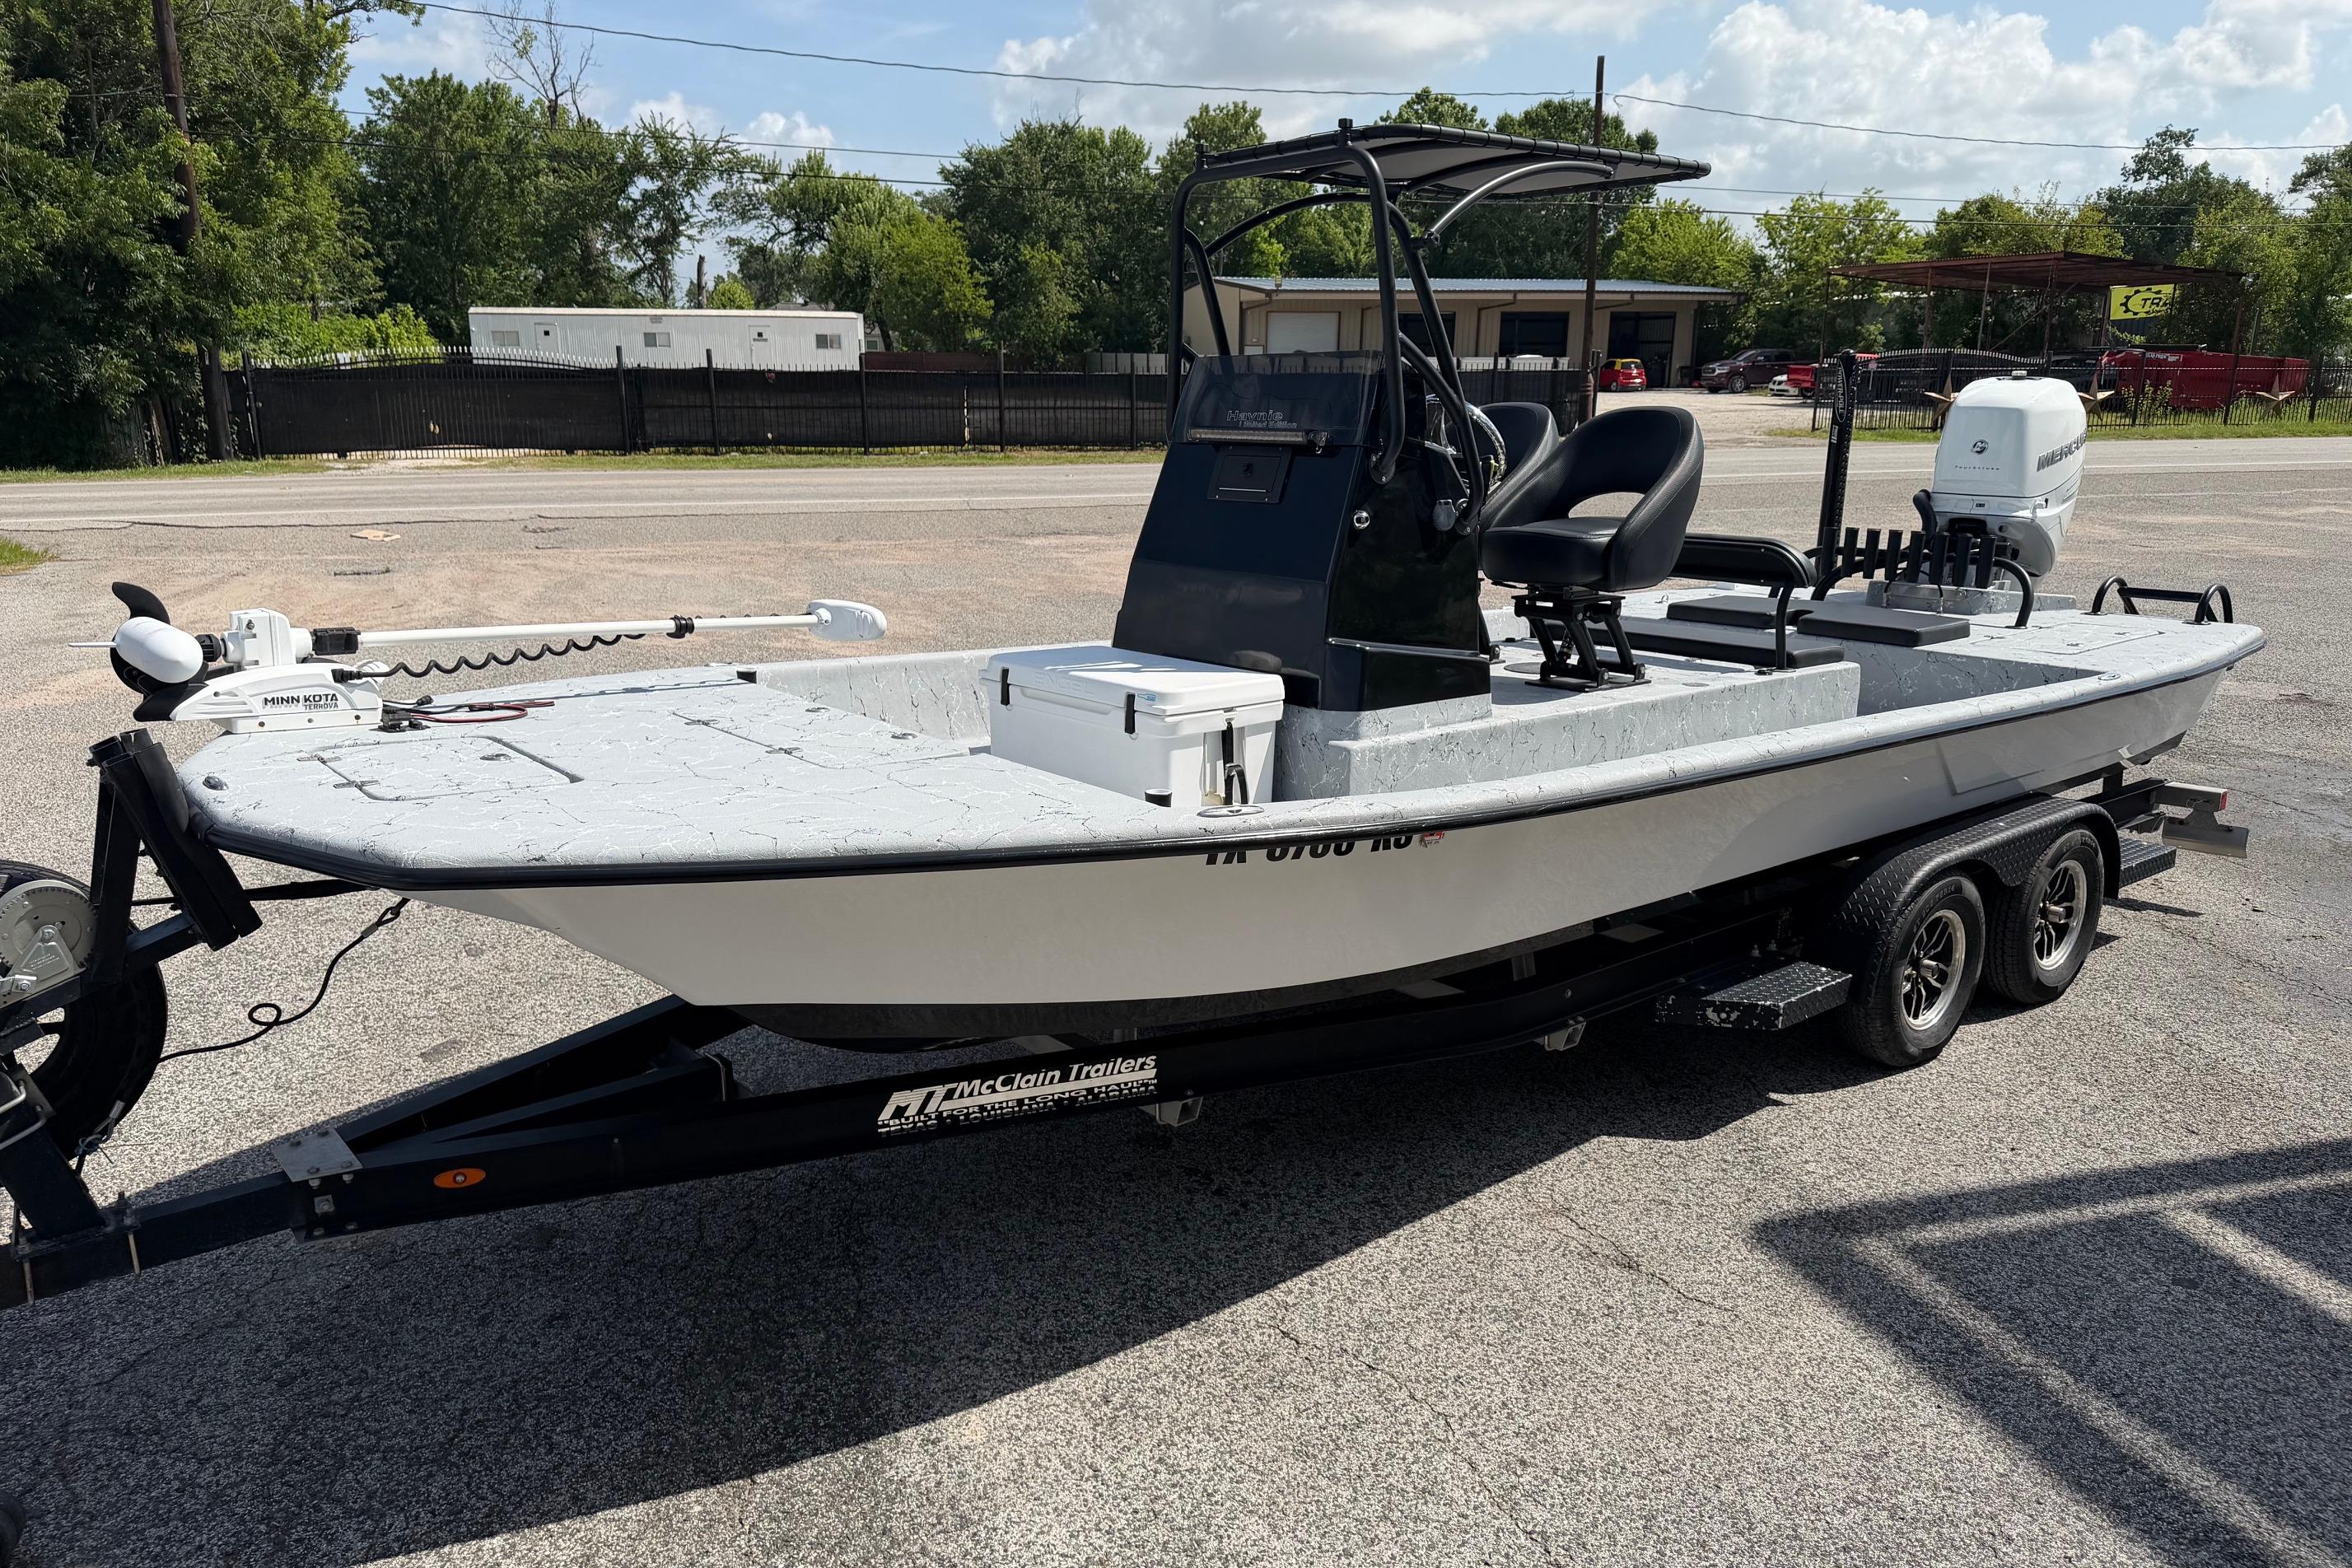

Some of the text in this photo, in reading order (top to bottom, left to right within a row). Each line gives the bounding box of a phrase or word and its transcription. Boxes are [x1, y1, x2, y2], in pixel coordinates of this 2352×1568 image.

[1227, 410, 1284, 422] Haynie
[264, 693, 338, 706] MINN KOTA
[304, 702, 338, 711] TERROVA
[953, 1055, 1157, 1099] McClain Trailers
[942, 1106, 980, 1118] FOR
[985, 1100, 1017, 1110] THE
[1024, 1090, 1087, 1104] LONG
